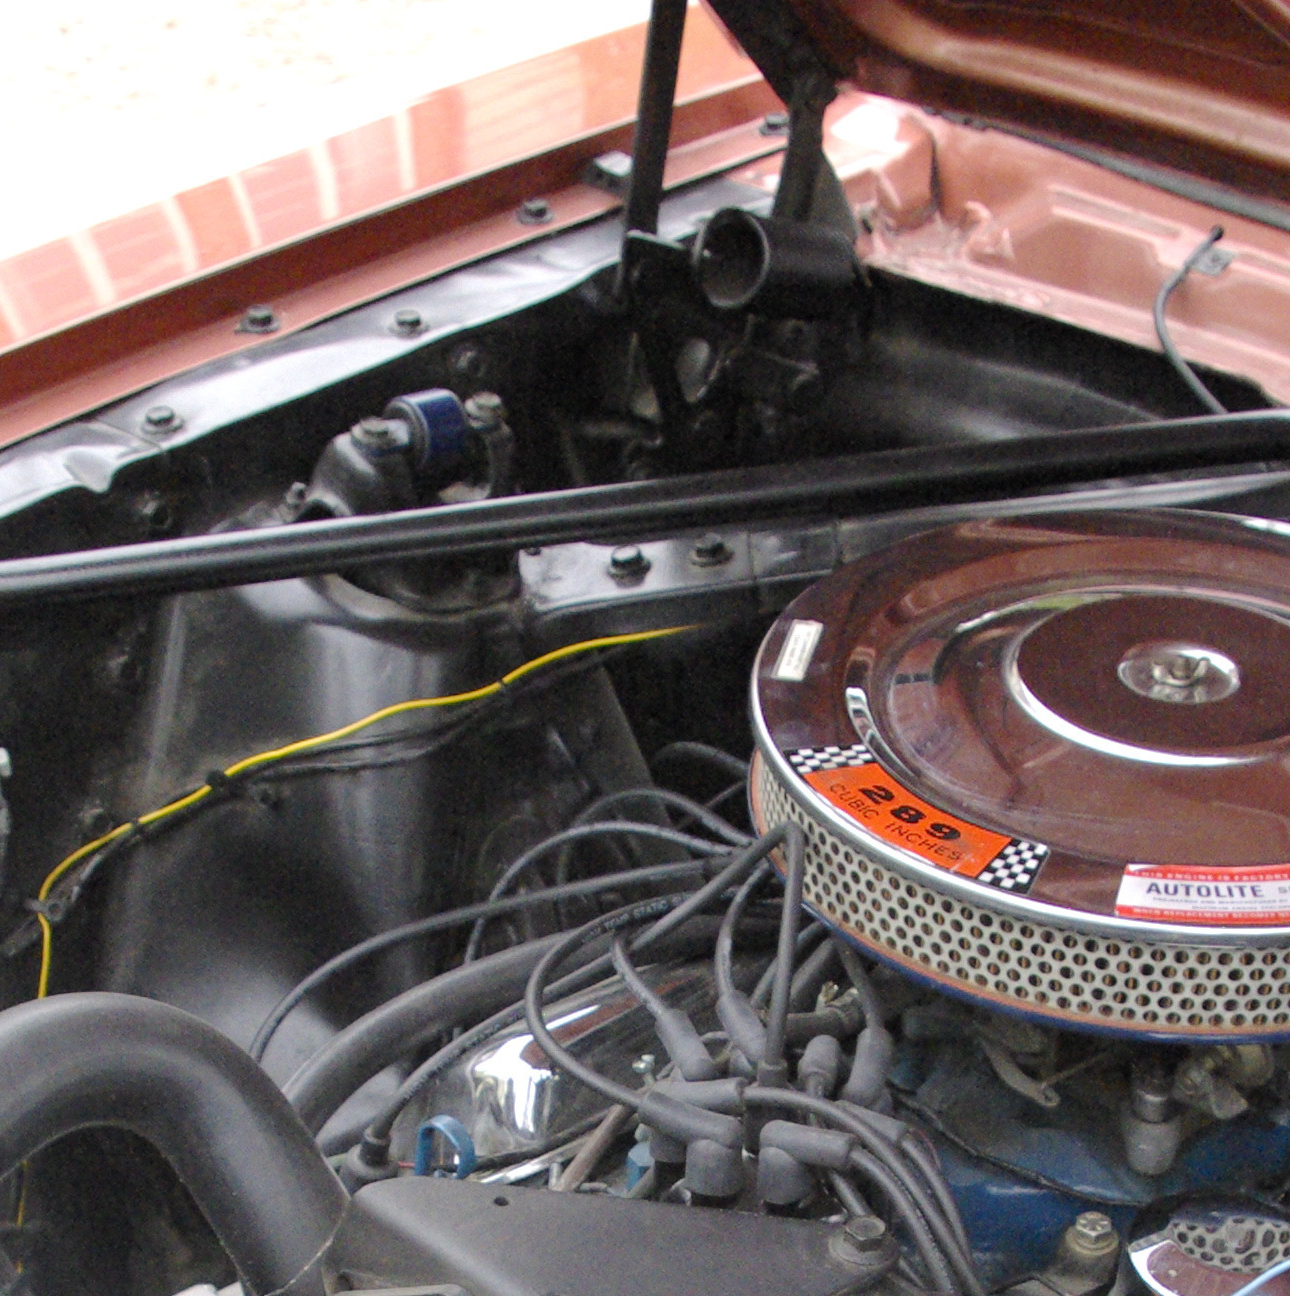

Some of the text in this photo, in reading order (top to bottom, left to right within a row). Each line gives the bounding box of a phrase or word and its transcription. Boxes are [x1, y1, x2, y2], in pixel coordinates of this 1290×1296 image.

[829, 783, 961, 861] CUBIC INCHES
[858, 784, 961, 841] 289
[1146, 881, 1265, 898] AUTOLITE
